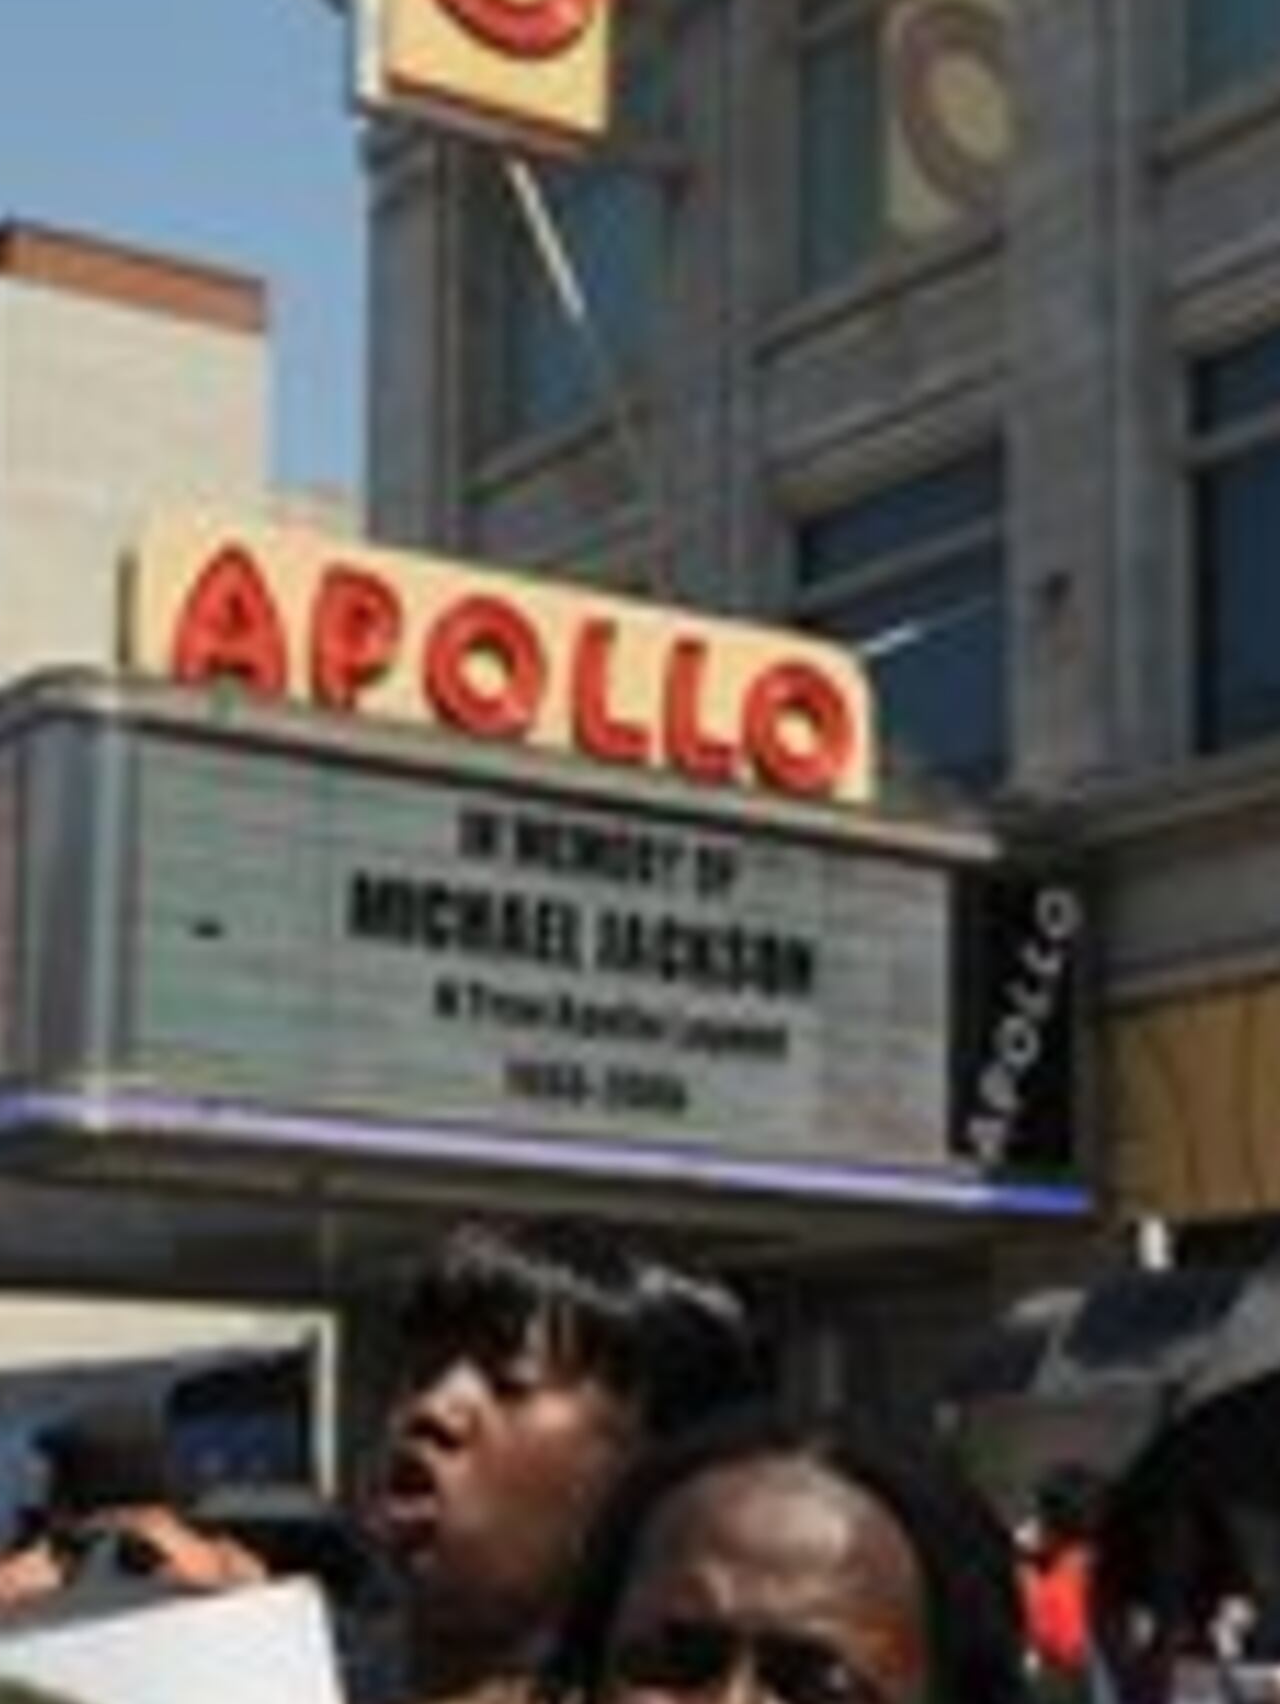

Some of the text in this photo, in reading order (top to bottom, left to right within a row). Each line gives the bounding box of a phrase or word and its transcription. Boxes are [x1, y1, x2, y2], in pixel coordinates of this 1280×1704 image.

[173, 541, 854, 798] APOLLO
[347, 872, 816, 996] MICHAEL JACKSON
[966, 890, 1080, 1160] APOLLO
